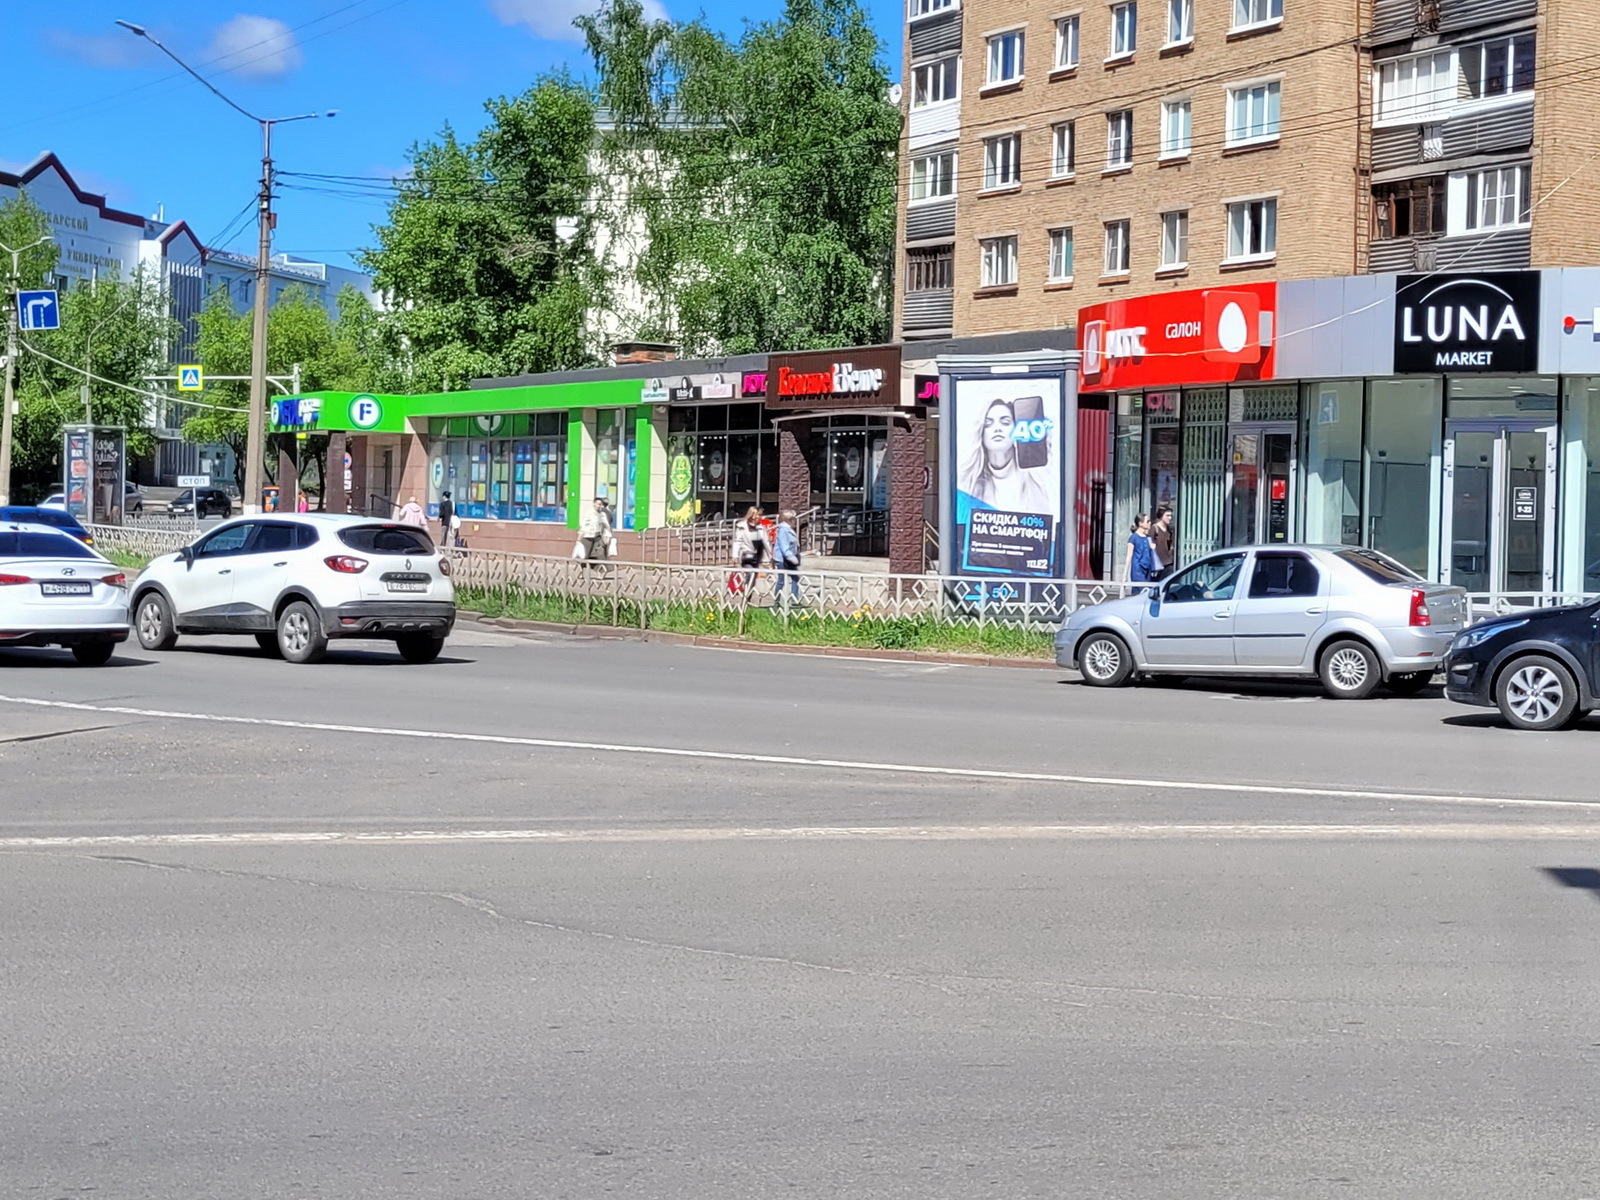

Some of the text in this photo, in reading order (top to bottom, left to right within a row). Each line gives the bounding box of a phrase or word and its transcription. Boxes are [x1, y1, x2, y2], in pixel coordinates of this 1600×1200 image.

[1165, 321, 1202, 339] салон
[1403, 305, 1525, 341] LUNA
[1435, 351, 1493, 366] MARKET
[1012, 419, 1054, 442] 40%
[182, 477, 206, 485] СТОП
[973, 512, 1044, 527] СКИДКА 40%
[972, 523, 1048, 539] НА СМАРТФОН
